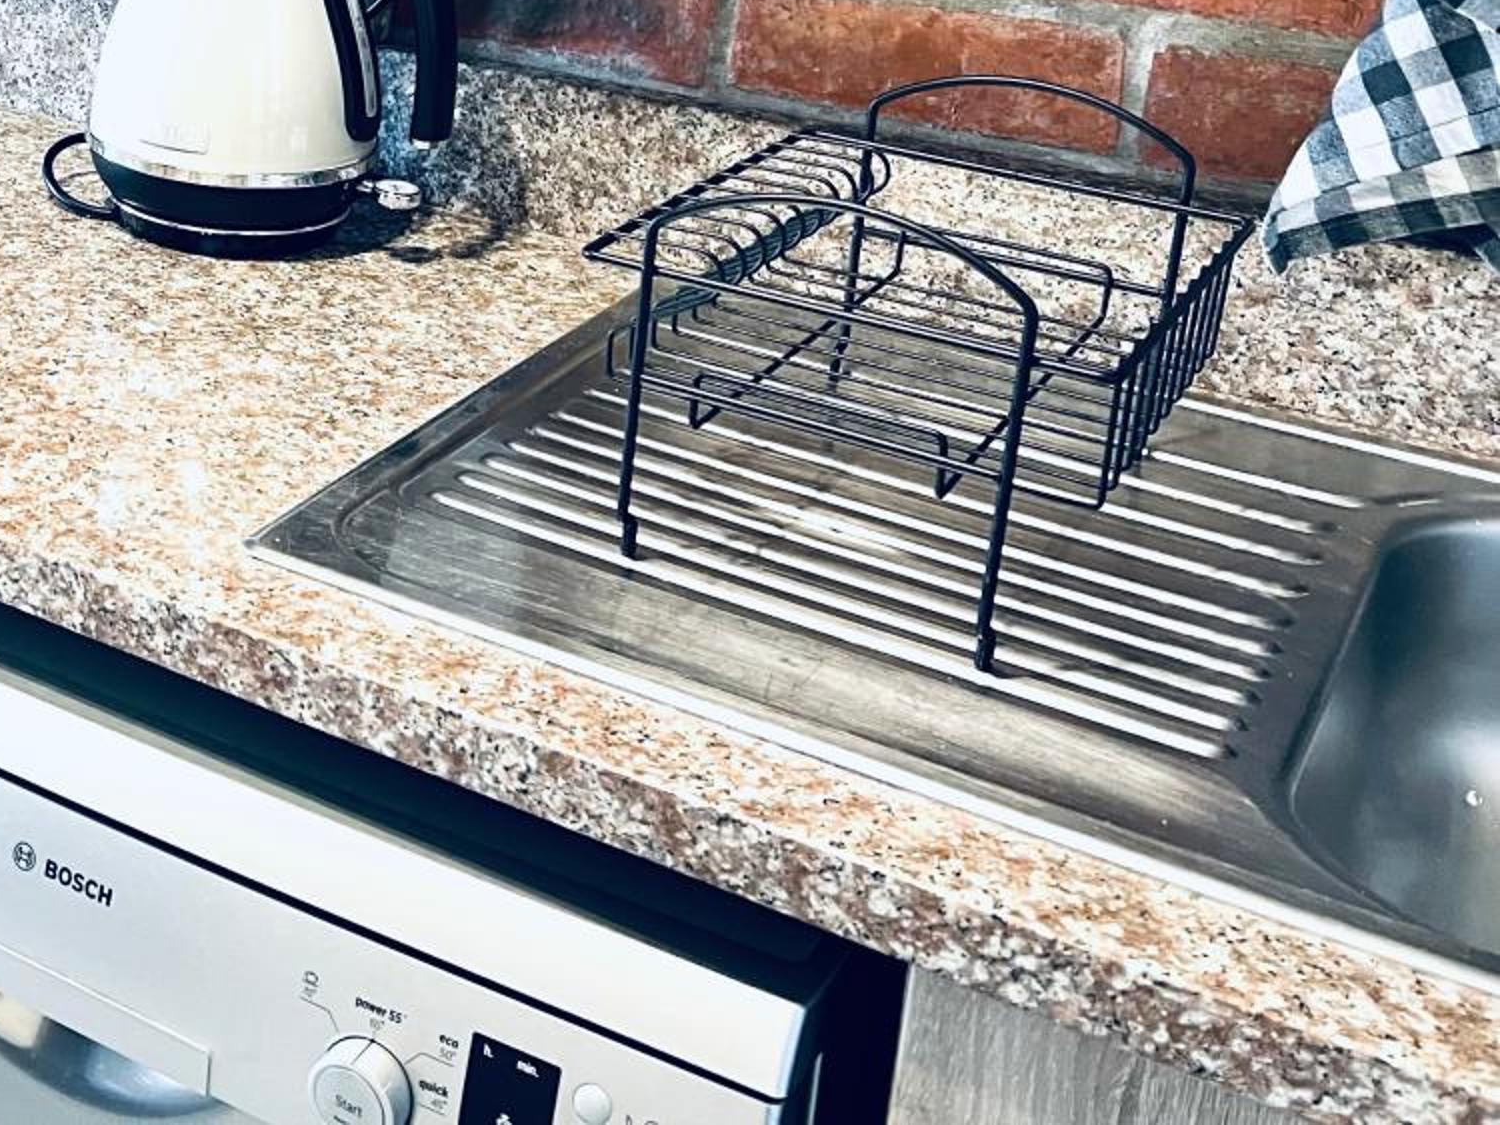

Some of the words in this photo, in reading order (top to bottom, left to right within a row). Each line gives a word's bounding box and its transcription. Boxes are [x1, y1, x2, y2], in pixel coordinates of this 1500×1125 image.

[45, 858, 113, 907] BOSCH
[355, 996, 387, 1016] power
[439, 1034, 459, 1049] eco
[418, 1080, 449, 1098] quick
[335, 1094, 363, 1118] Start
